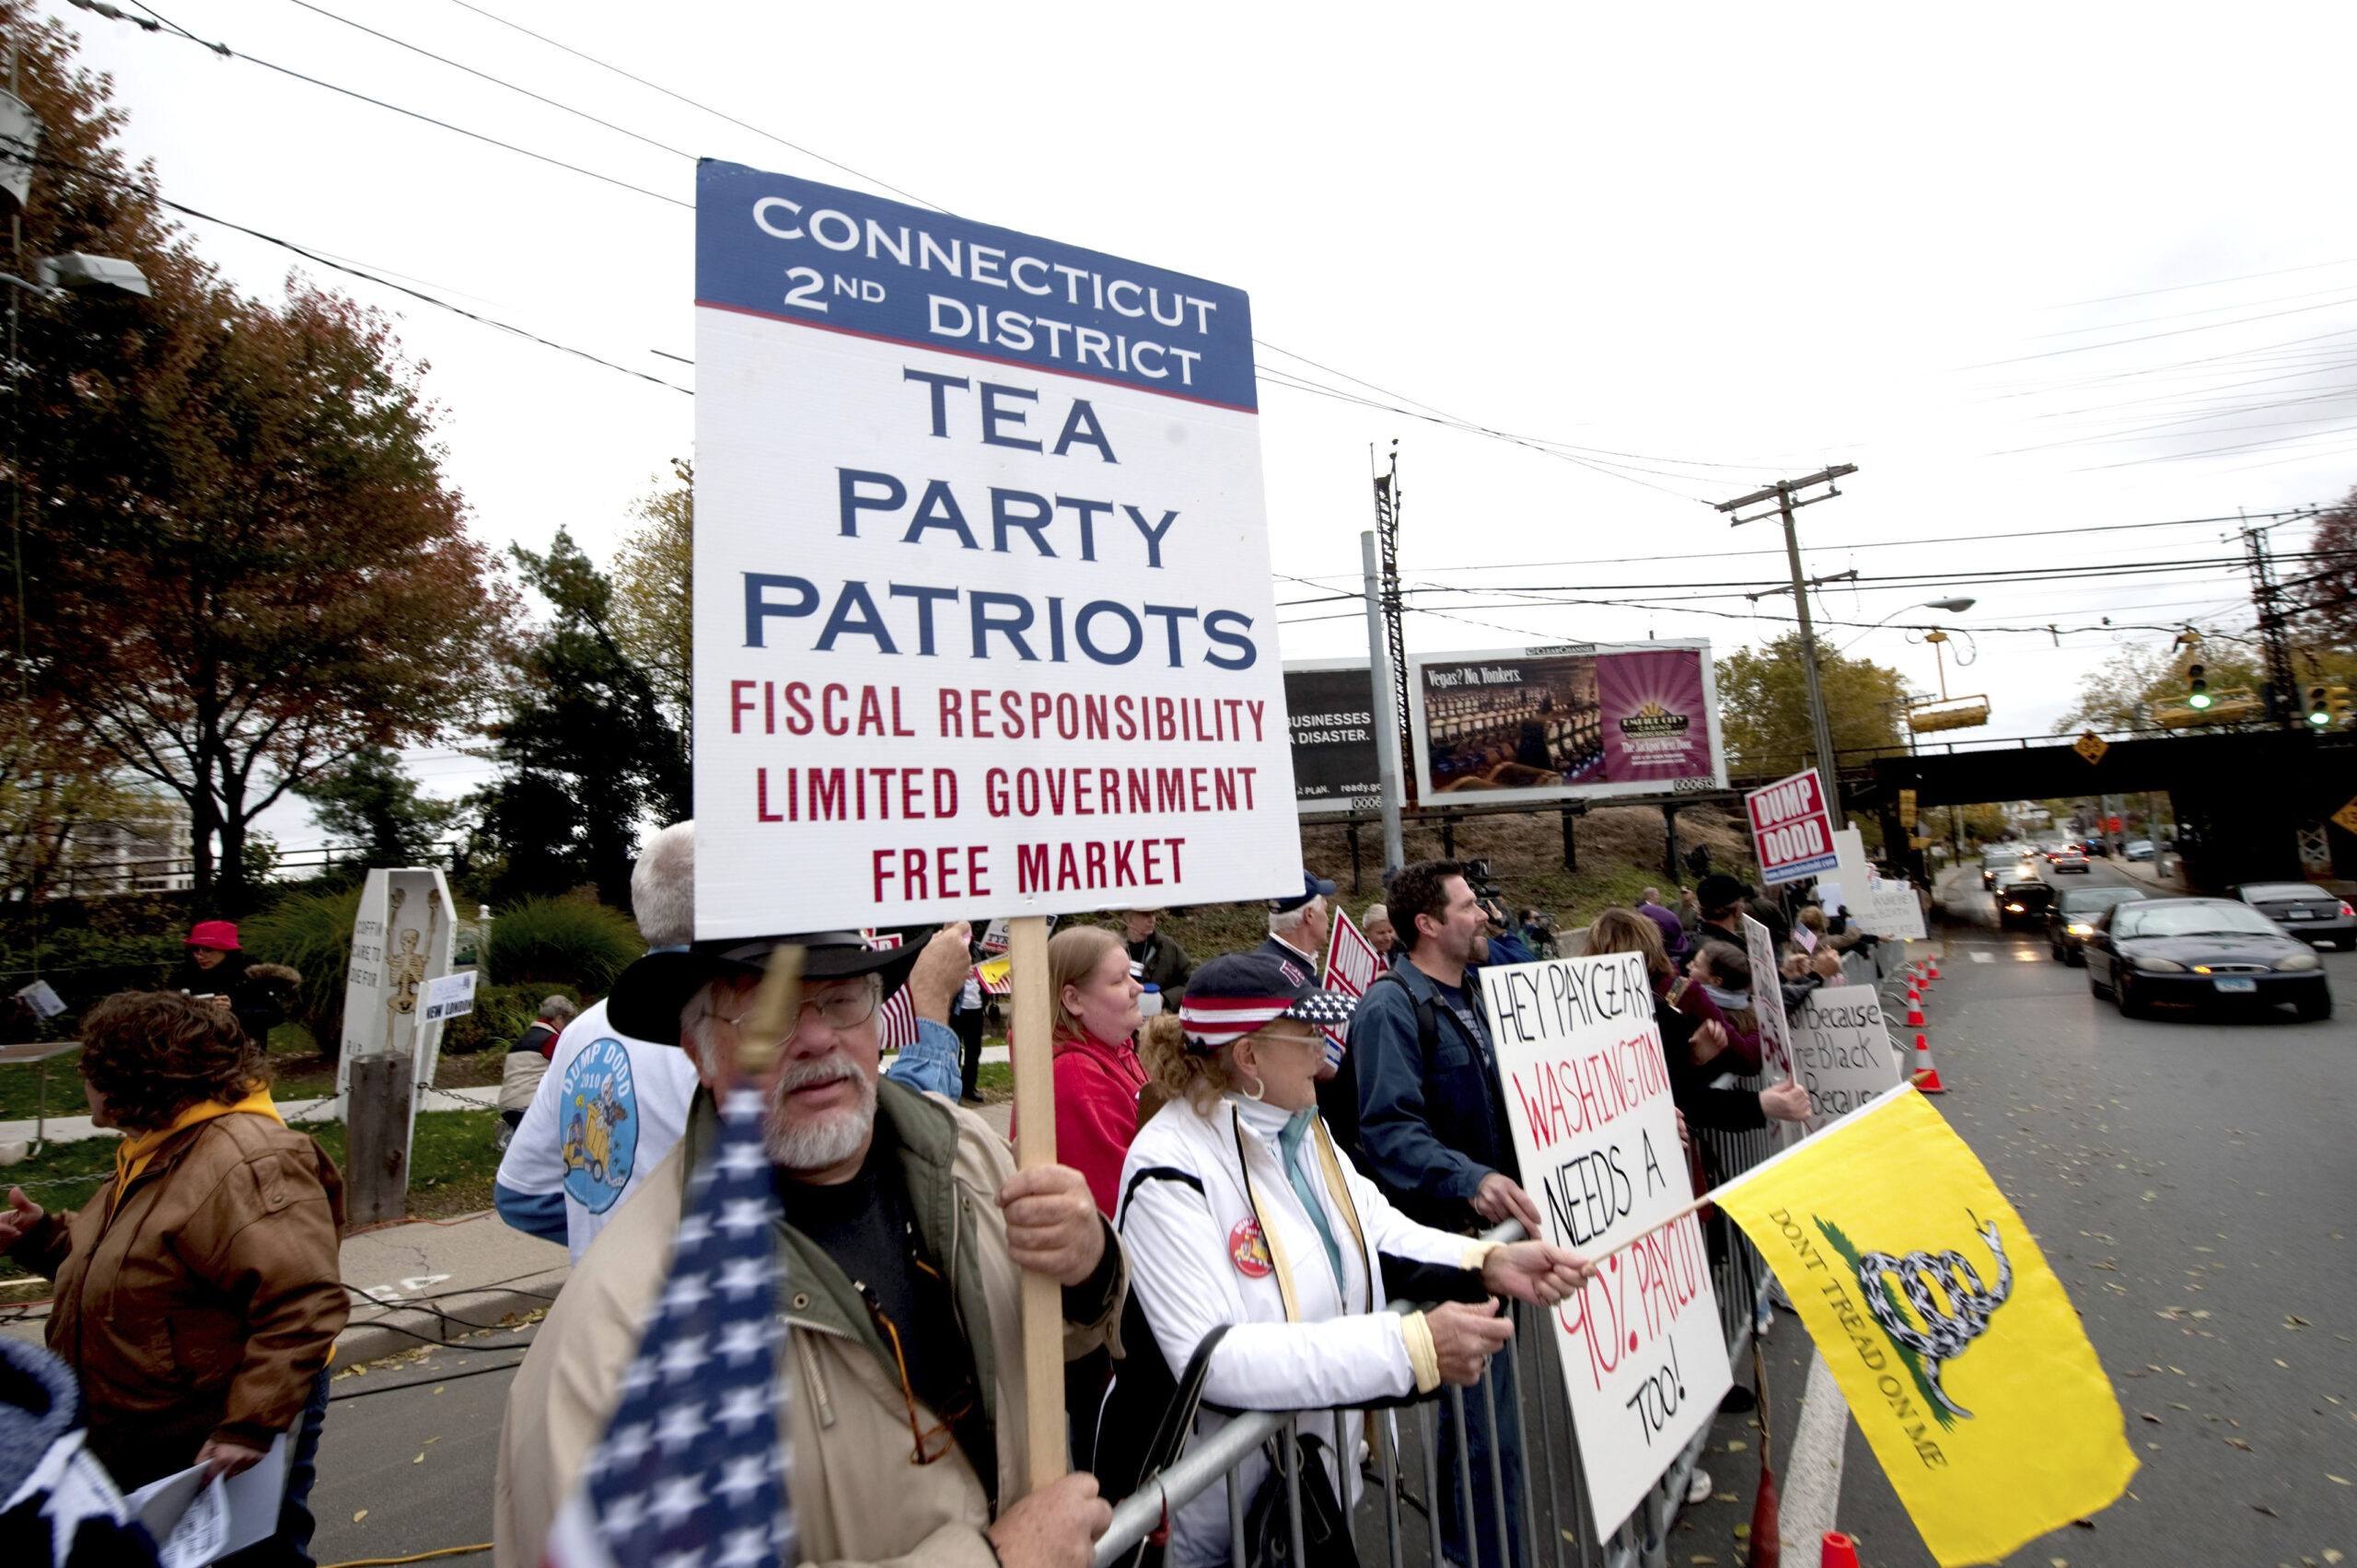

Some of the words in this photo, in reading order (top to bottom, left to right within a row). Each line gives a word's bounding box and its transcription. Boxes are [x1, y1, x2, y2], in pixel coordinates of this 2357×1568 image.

[752, 196, 1216, 334] CONNECTICUT
[784, 266, 886, 312] 2ND
[928, 293, 1201, 385] DISTRICT
[903, 365, 1121, 465] TEA
[834, 466, 1180, 568] PARTY
[740, 571, 1257, 670] PATRIOTS
[730, 679, 915, 737] FISCAL
[939, 688, 1265, 741] RESPONSIBILITY
[1428, 668, 1462, 689] Vegas?
[1480, 666, 1522, 684] Yonkers.
[1298, 729, 1370, 744] DISASTER.
[757, 768, 958, 822] LIMITED
[986, 767, 1257, 818] GOVERNMENT
[1755, 778, 1812, 827] DUMP
[873, 845, 991, 903] FREE
[1016, 838, 1185, 893] MARKET
[1763, 819, 1824, 864] DODD
[1335, 923, 1375, 996] DUMP
[1492, 969, 1546, 1044] HEY
[563, 1044, 601, 1096] DUMP
[603, 1044, 631, 1098] DODD
[580, 1073, 600, 1088] 2010
[1814, 1029, 1880, 1070] Black
[1513, 1028, 1668, 1151] WASHINGTON
[1805, 1071, 1886, 1116] Becaus
[1544, 1145, 1631, 1248] NEEDS
[1643, 1128, 1666, 1198] A
[1770, 1208, 1828, 1272] DONT
[1821, 1278, 1886, 1371] TREAD
[1627, 1333, 1685, 1446] TOO!
[1877, 1376, 1918, 1419] ON
[1904, 1423, 1948, 1469] ME
